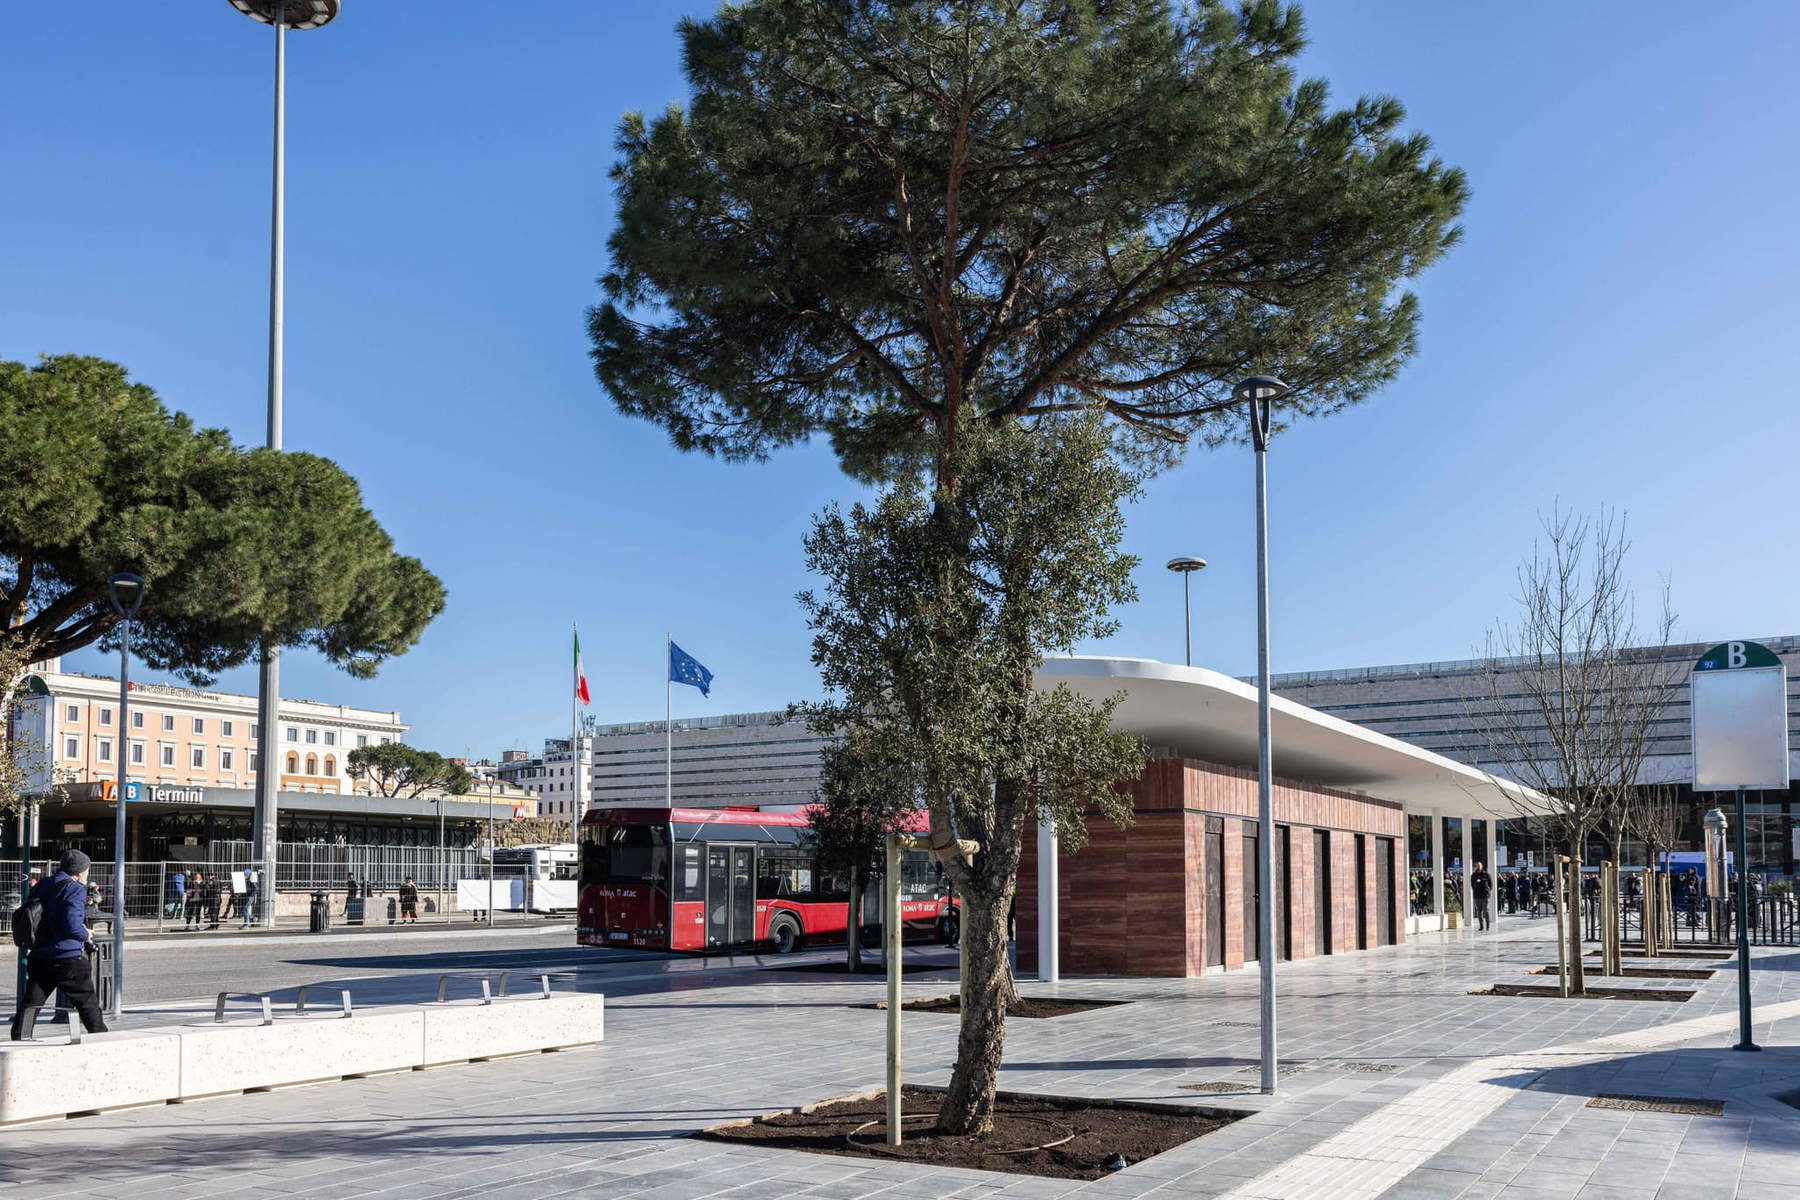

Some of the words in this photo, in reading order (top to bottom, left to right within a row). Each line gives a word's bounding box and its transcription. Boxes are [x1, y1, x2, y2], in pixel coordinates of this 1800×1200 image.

[1728, 641, 1747, 668] B
[110, 785, 118, 800] A
[128, 785, 137, 799] B
[149, 785, 204, 803] Termini
[622, 889, 637, 898] atac
